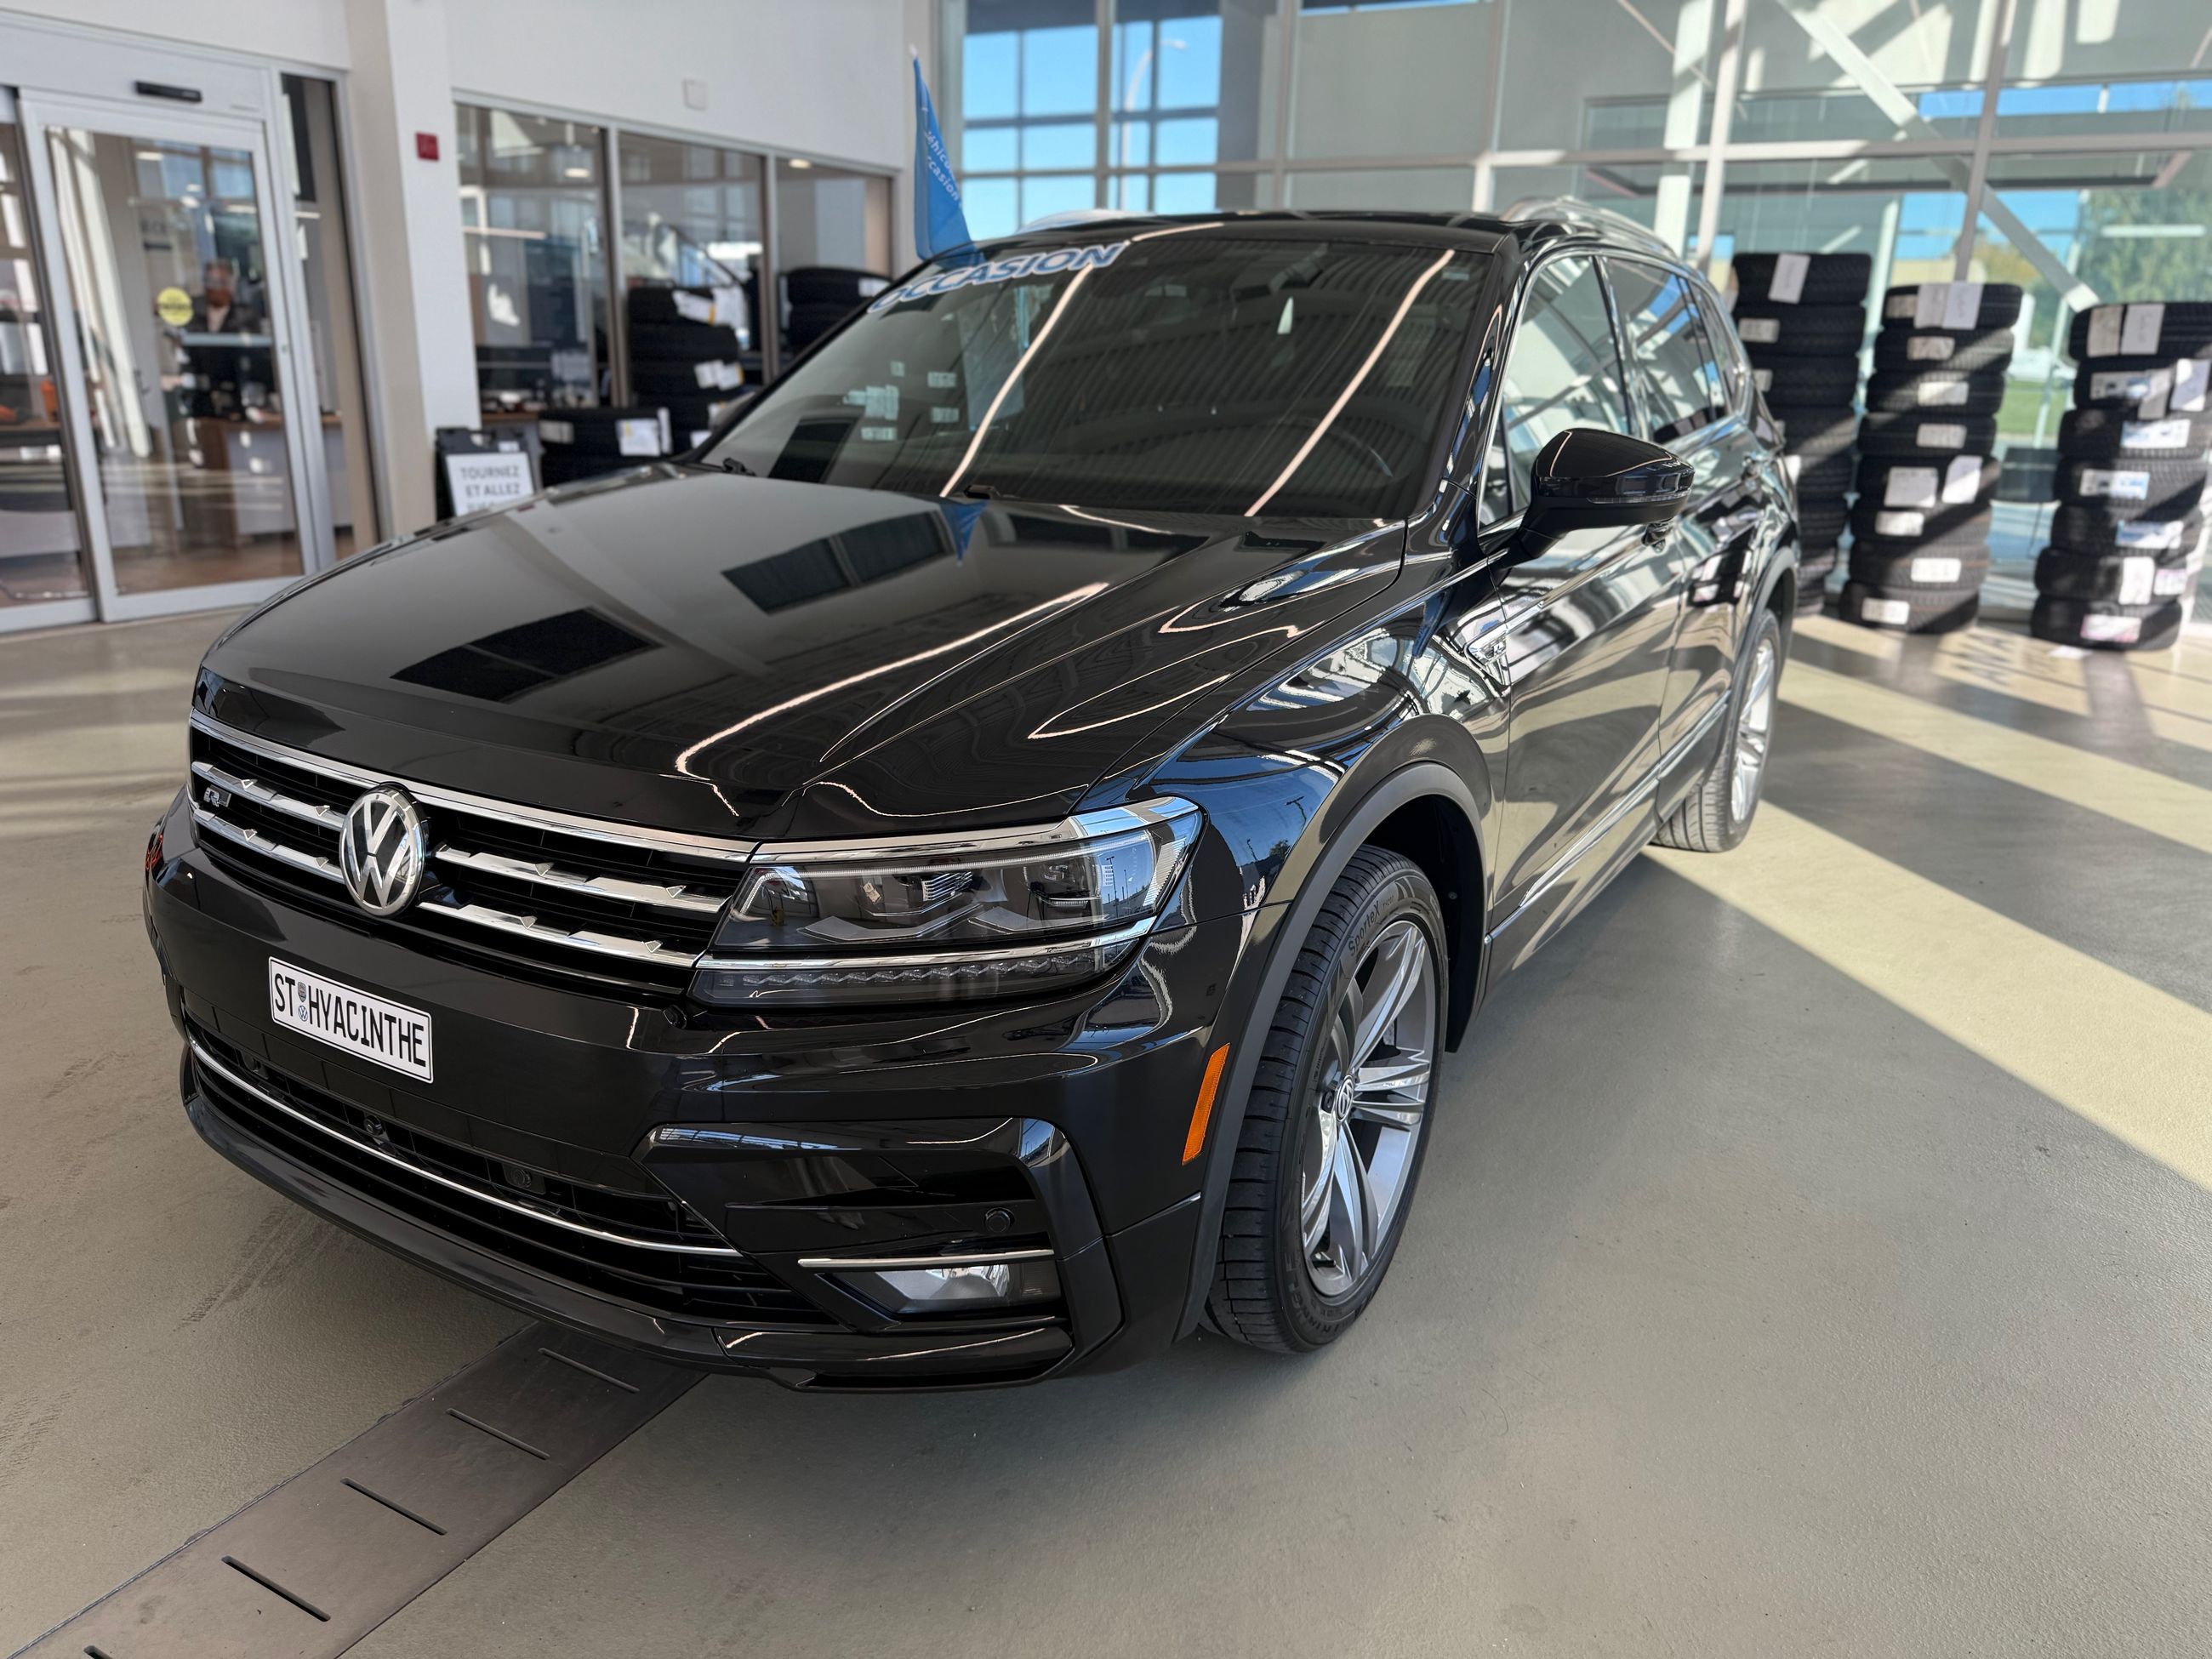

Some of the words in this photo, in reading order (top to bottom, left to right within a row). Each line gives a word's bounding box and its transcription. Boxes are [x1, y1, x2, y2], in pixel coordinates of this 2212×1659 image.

[868, 243, 1126, 312] OCCASION
[460, 465, 519, 479] TOURNEZ
[465, 485, 481, 498] ET
[484, 483, 520, 495] ALLEZ
[275, 973, 295, 1017] ST
[309, 985, 426, 1067] HYACINTHE
